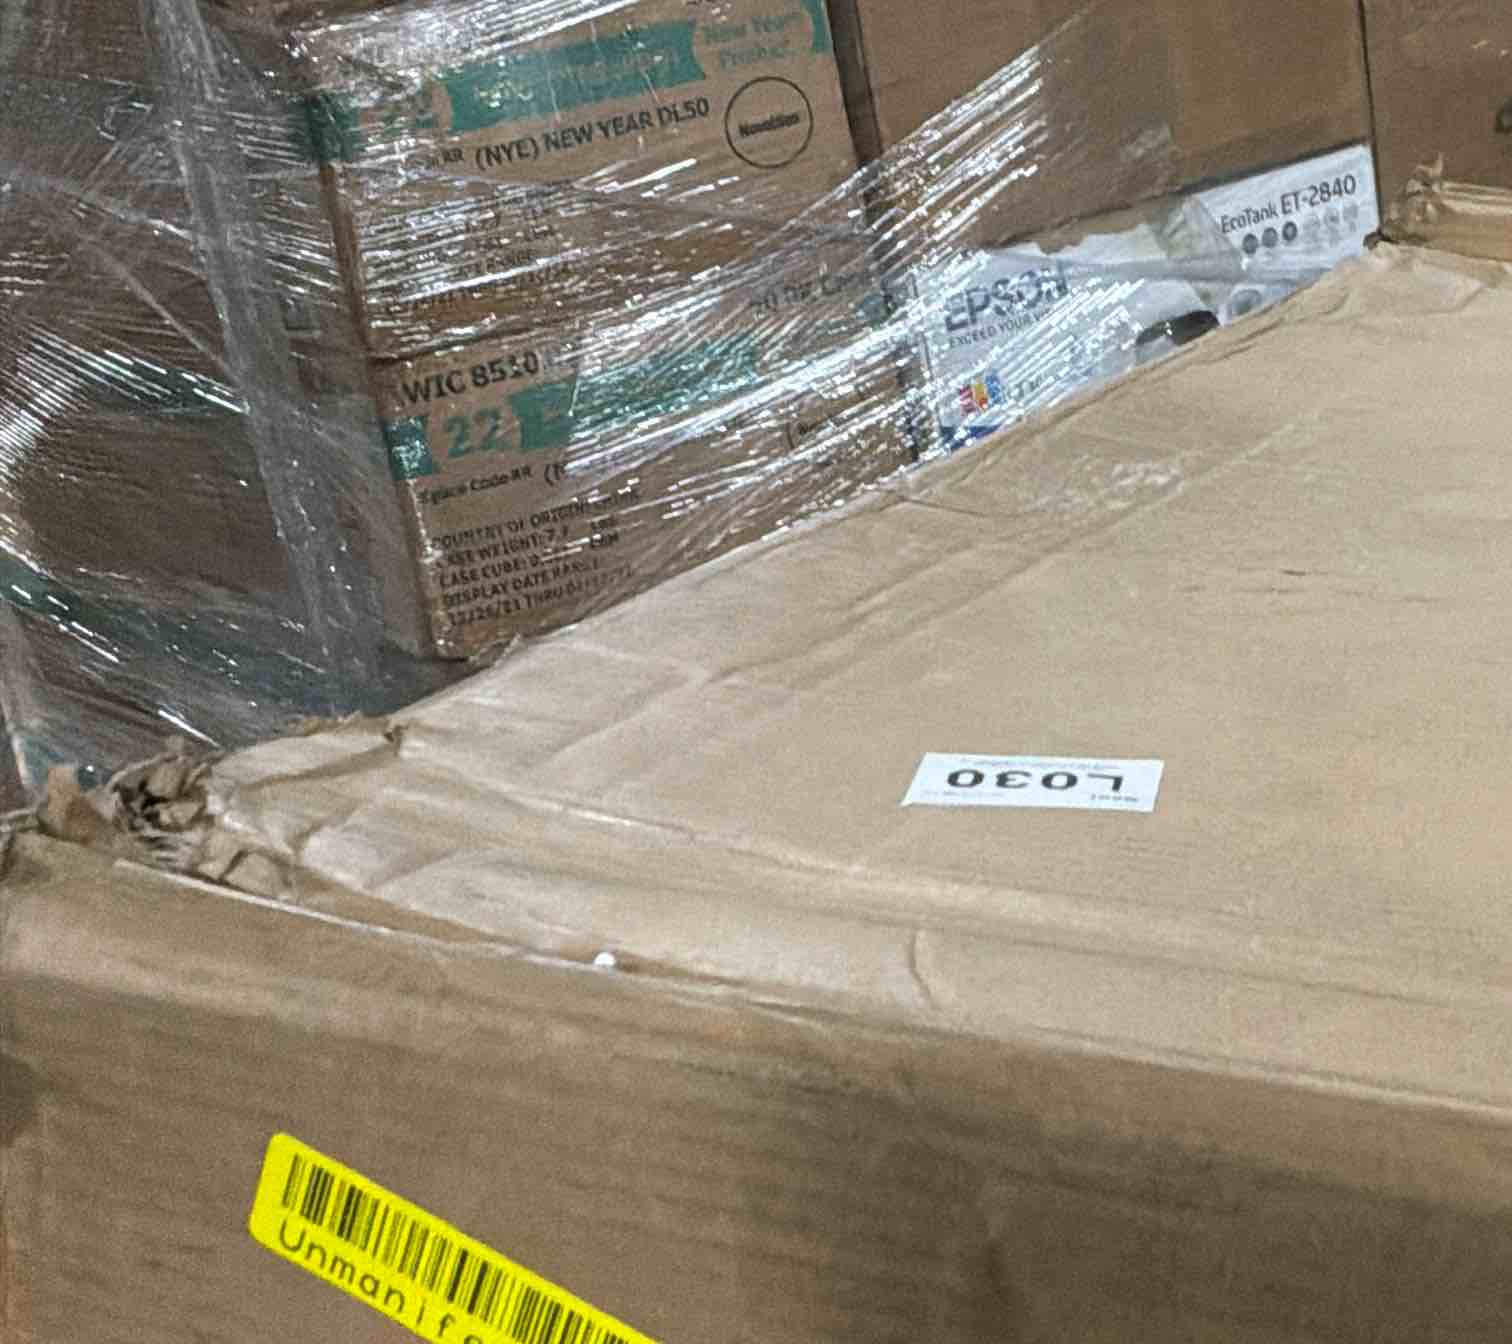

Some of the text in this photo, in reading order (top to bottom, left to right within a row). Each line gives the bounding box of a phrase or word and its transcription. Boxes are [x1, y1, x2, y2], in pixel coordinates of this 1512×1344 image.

[475, 136, 540, 172] (NYE)
[542, 122, 594, 151] NEW
[595, 111, 654, 140] YEAR
[1220, 173, 1357, 233] EcoTank ET-2840
[946, 768, 1124, 794] L030
